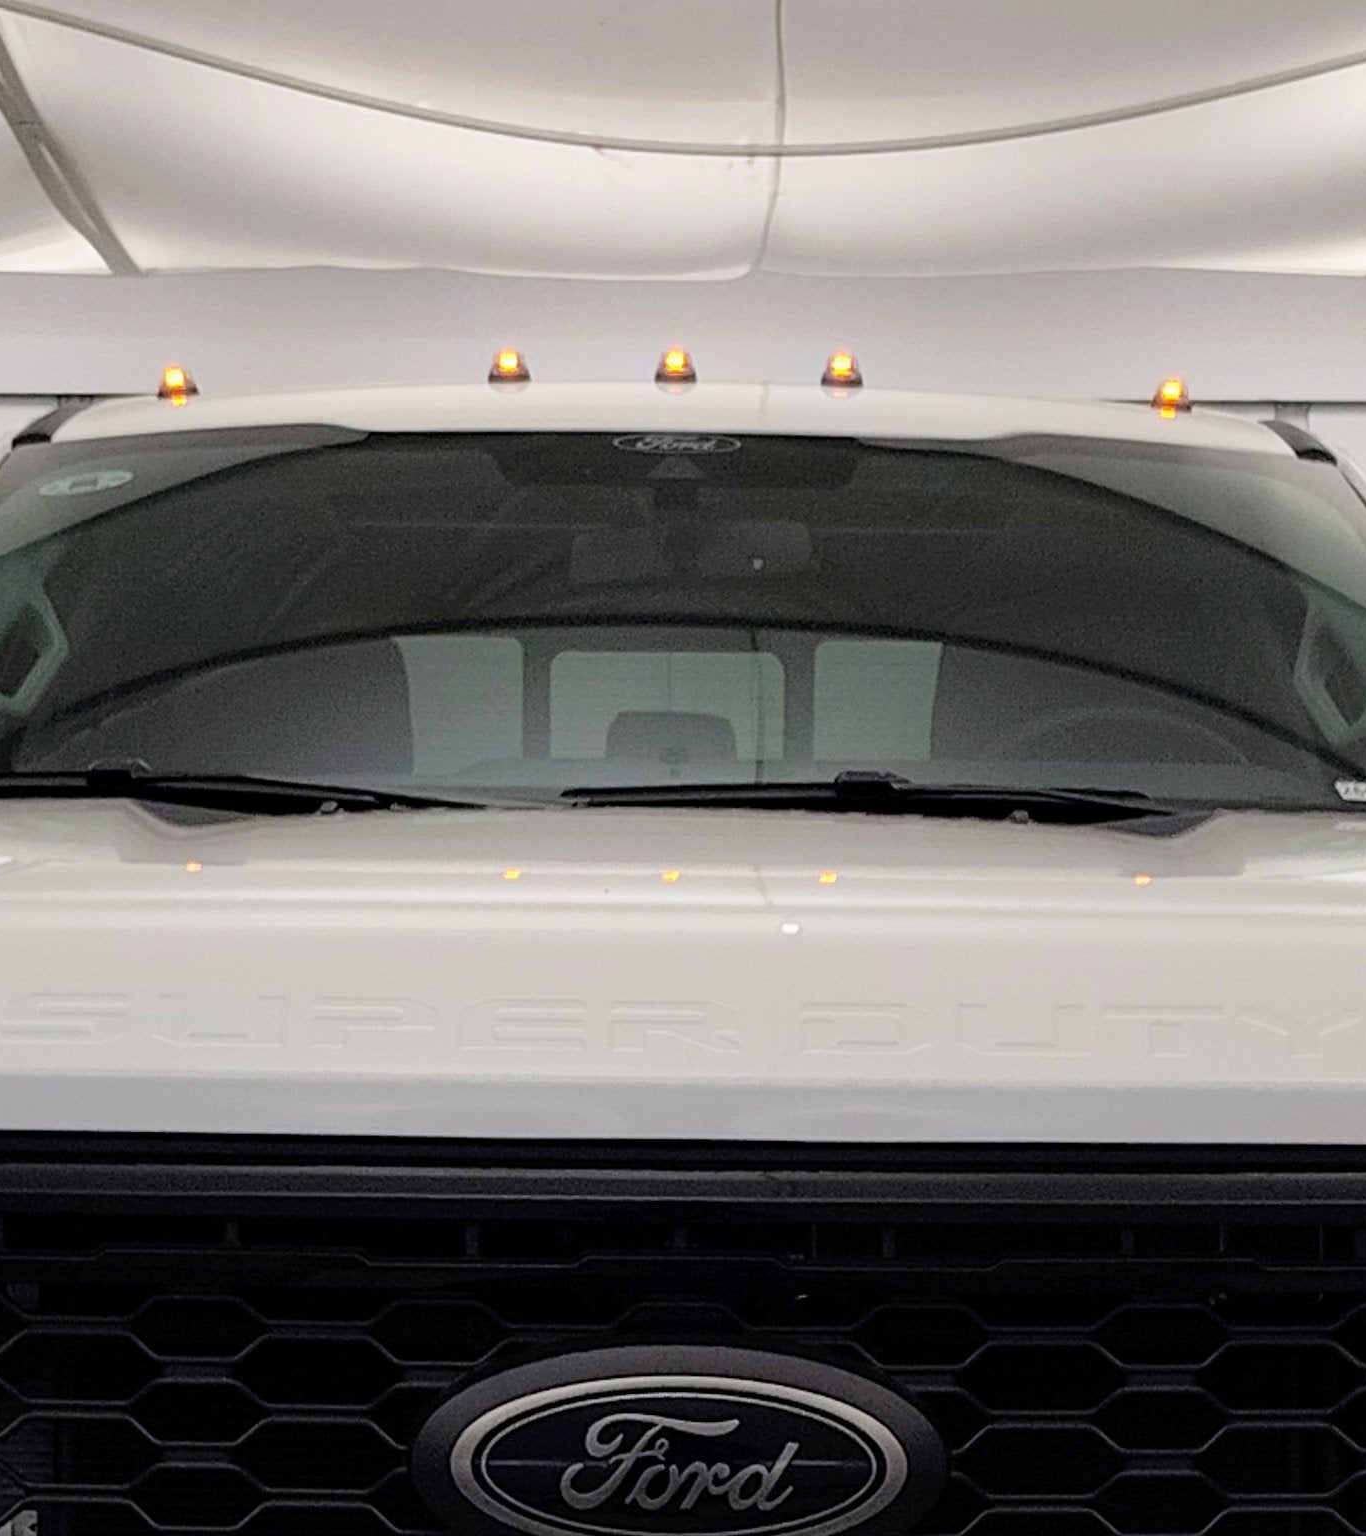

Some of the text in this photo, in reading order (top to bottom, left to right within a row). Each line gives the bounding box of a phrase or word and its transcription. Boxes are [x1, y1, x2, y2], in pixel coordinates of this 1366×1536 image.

[635, 435, 717, 453] Ford
[798, 1000, 1363, 1060] DUTY
[560, 1413, 800, 1511] Ford
